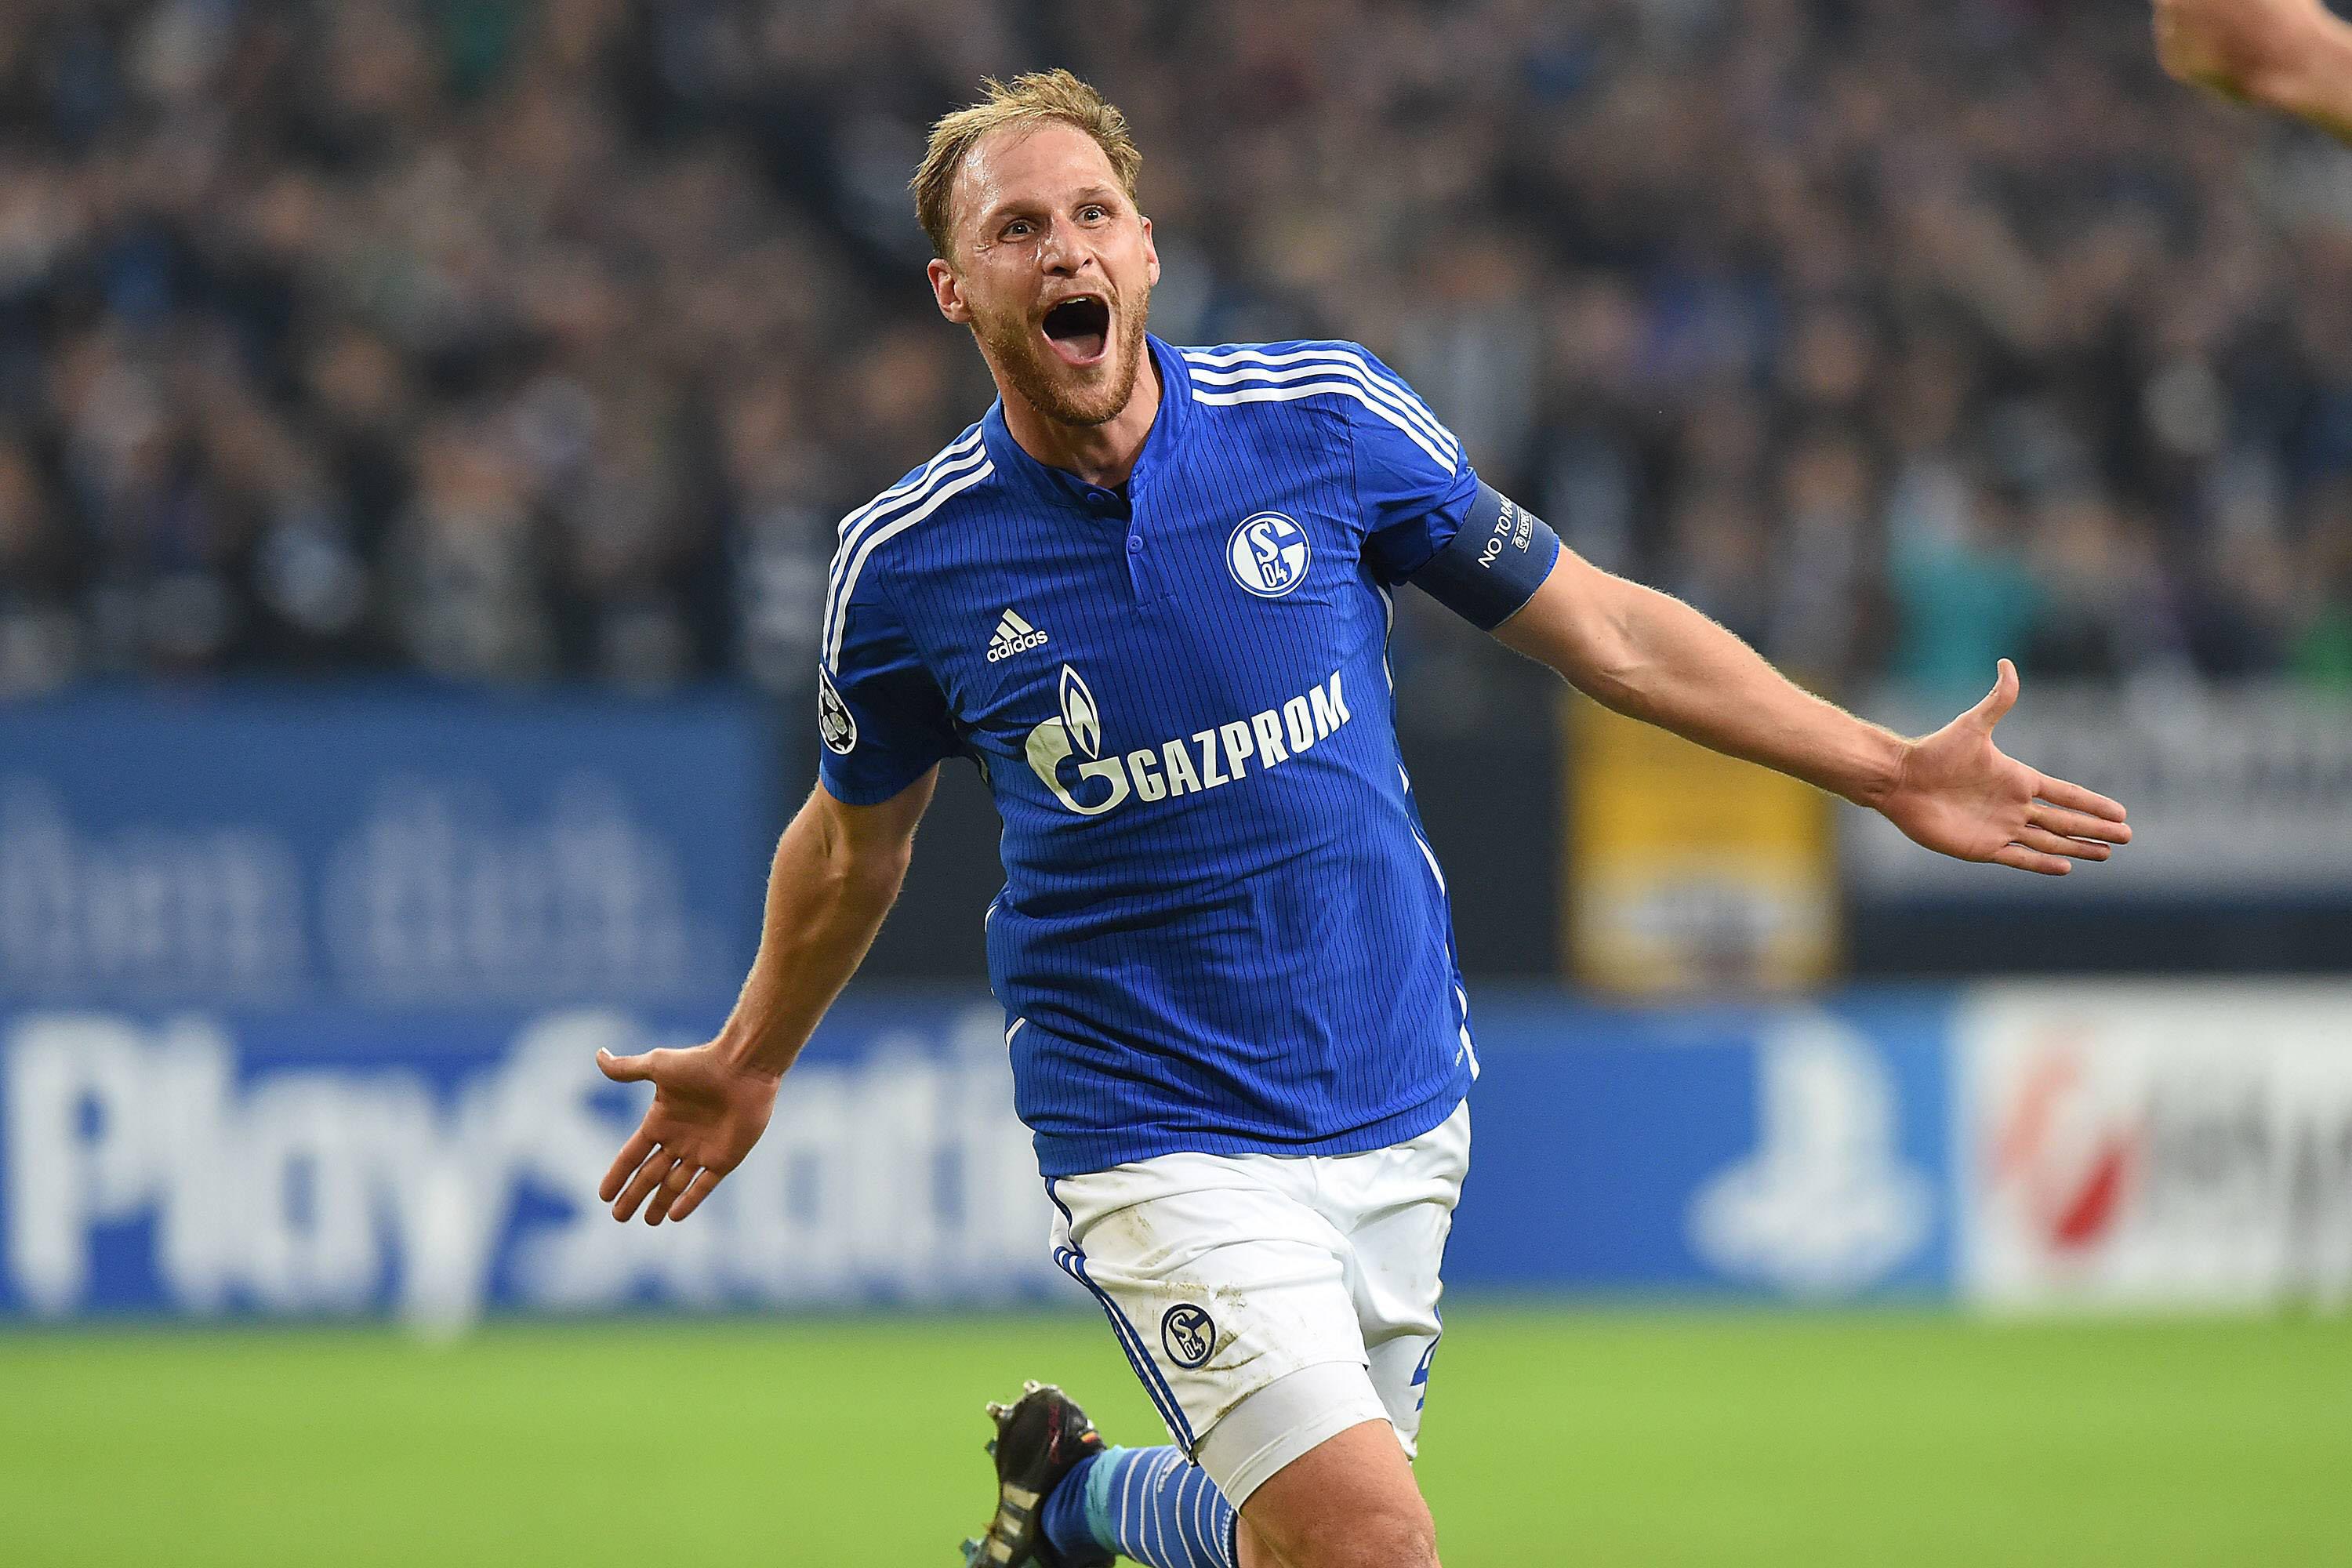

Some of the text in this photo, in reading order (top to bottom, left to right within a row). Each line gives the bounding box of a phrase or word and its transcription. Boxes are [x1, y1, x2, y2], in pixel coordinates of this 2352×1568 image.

[1477, 537, 1502, 568] NO
[1494, 515, 1512, 537] TO
[1261, 559, 1288, 587] 04
[986, 630, 1048, 662] adidas
[1127, 669, 1352, 802] GAZPROM
[1184, 1338, 1203, 1358] 04
